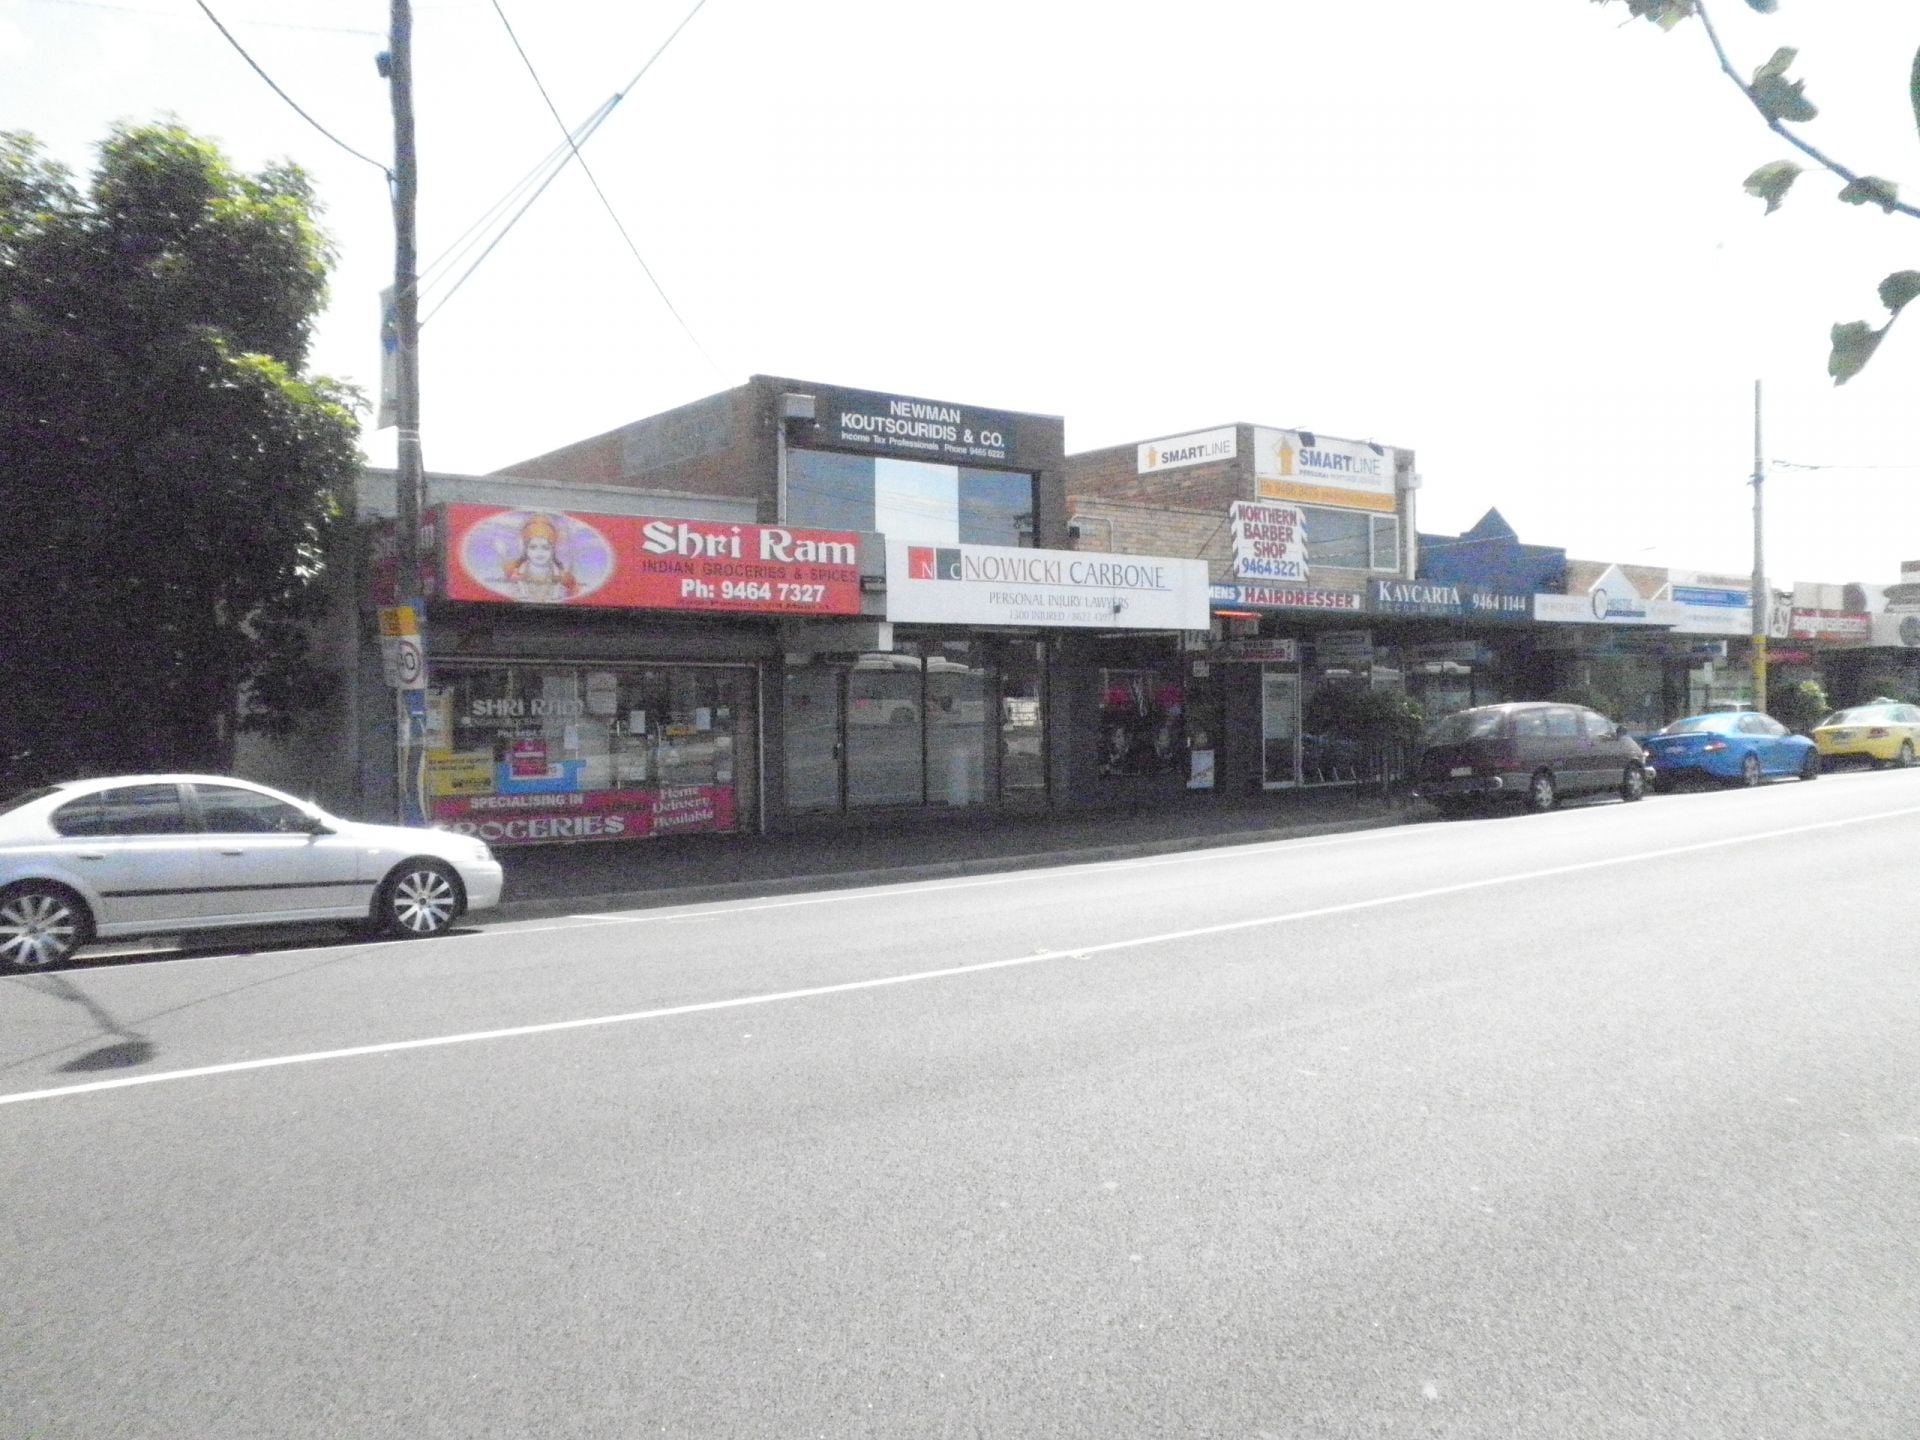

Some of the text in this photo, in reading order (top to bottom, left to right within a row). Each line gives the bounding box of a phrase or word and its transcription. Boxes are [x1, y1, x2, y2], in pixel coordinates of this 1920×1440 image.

[890, 400, 960, 424] NEWMAN
[841, 412, 1005, 448] KOUTSOURIDIS & CO.
[841, 431, 871, 443] Income
[873, 434, 887, 444] Tax
[889, 437, 940, 451] Professionals
[944, 443, 968, 455] Phone
[1161, 439, 1232, 464] SMARTLINE
[1299, 449, 1381, 476] SMARTLINE
[1237, 503, 1297, 525] NORTHERN
[642, 520, 856, 565] Shri Ram
[1243, 523, 1294, 543] BARBER
[1253, 541, 1287, 559] SHOP
[641, 560, 695, 576] INDIAN
[702, 562, 786, 579] GROCERIES
[810, 569, 858, 583] SPICES
[964, 555, 1165, 588] NOWICKI CARBONE
[680, 578, 825, 603] Ph: 9464 7327
[989, 592, 1129, 610] PERSONAL INJURY LAWYERS
[1244, 587, 1355, 608] HAIRDRESSER
[1378, 580, 1461, 605] KAYCARTA
[1472, 592, 1499, 610] 9464
[470, 793, 585, 809] SPECIALISING IN
